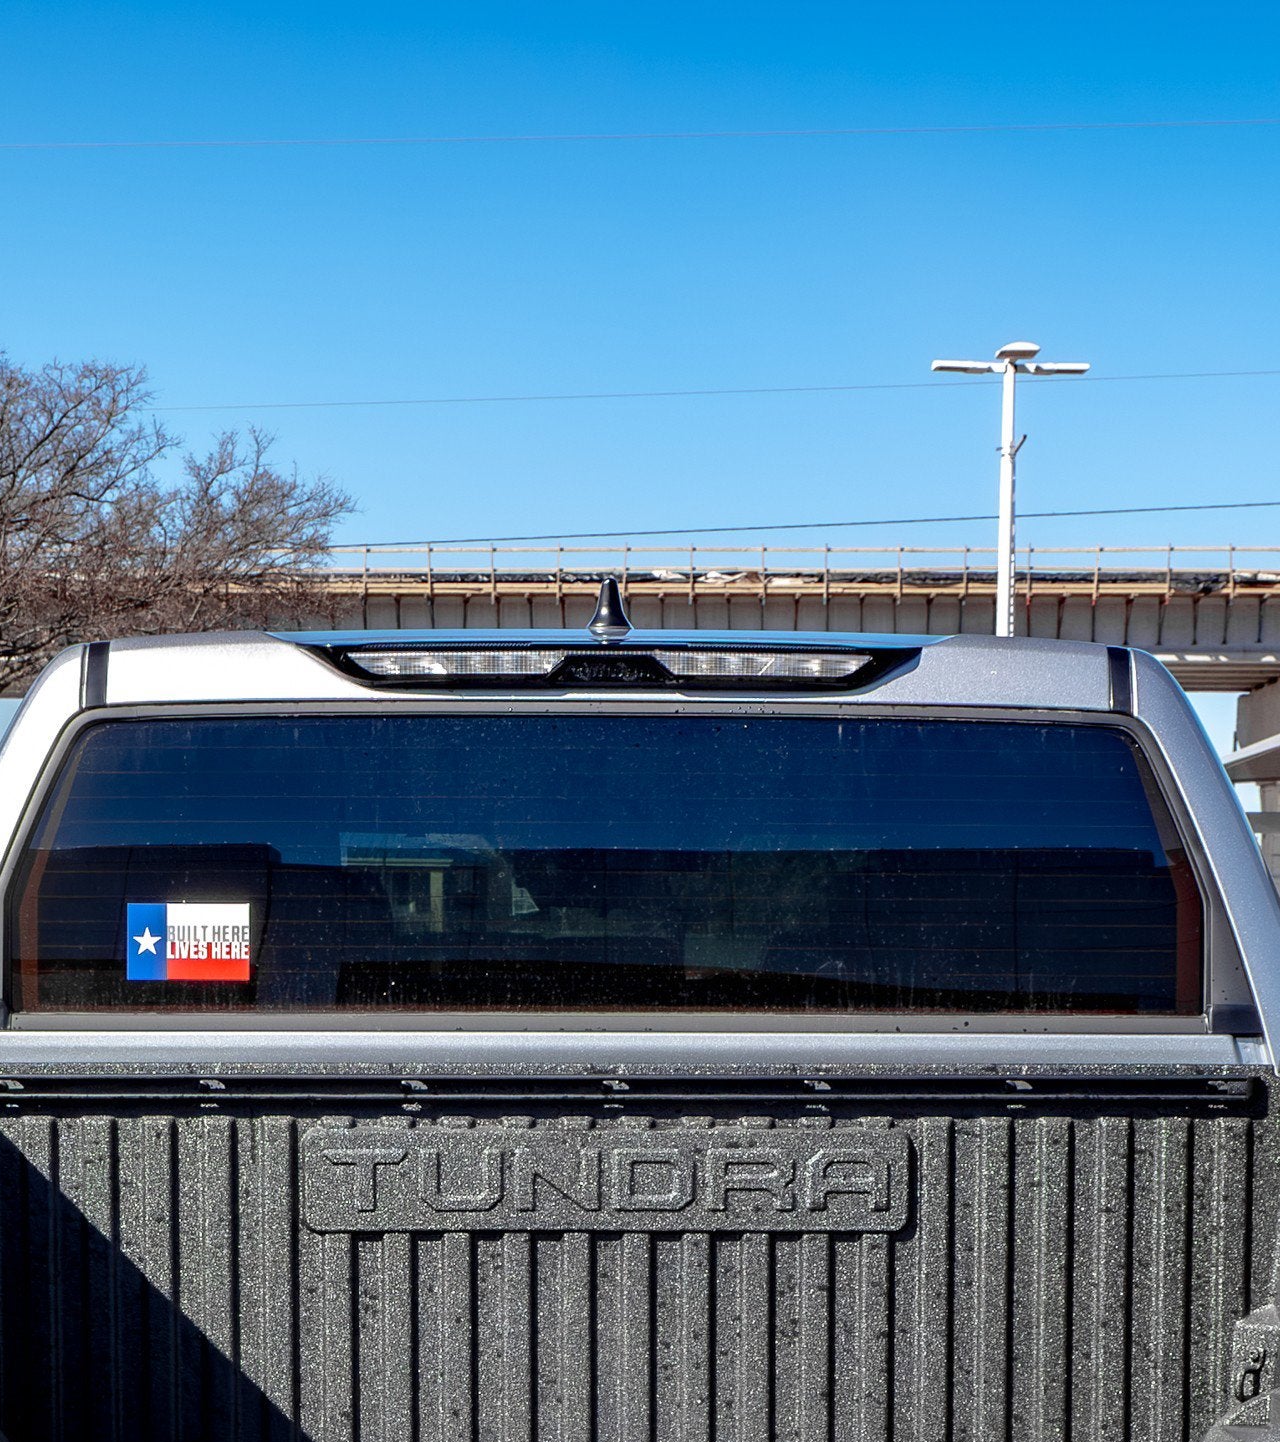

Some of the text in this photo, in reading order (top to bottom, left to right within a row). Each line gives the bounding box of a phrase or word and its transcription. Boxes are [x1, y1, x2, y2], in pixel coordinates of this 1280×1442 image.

[167, 925, 250, 942] BUILT HERE
[166, 941, 250, 960] LIVES HERE
[320, 1147, 892, 1213] TUNDRA
